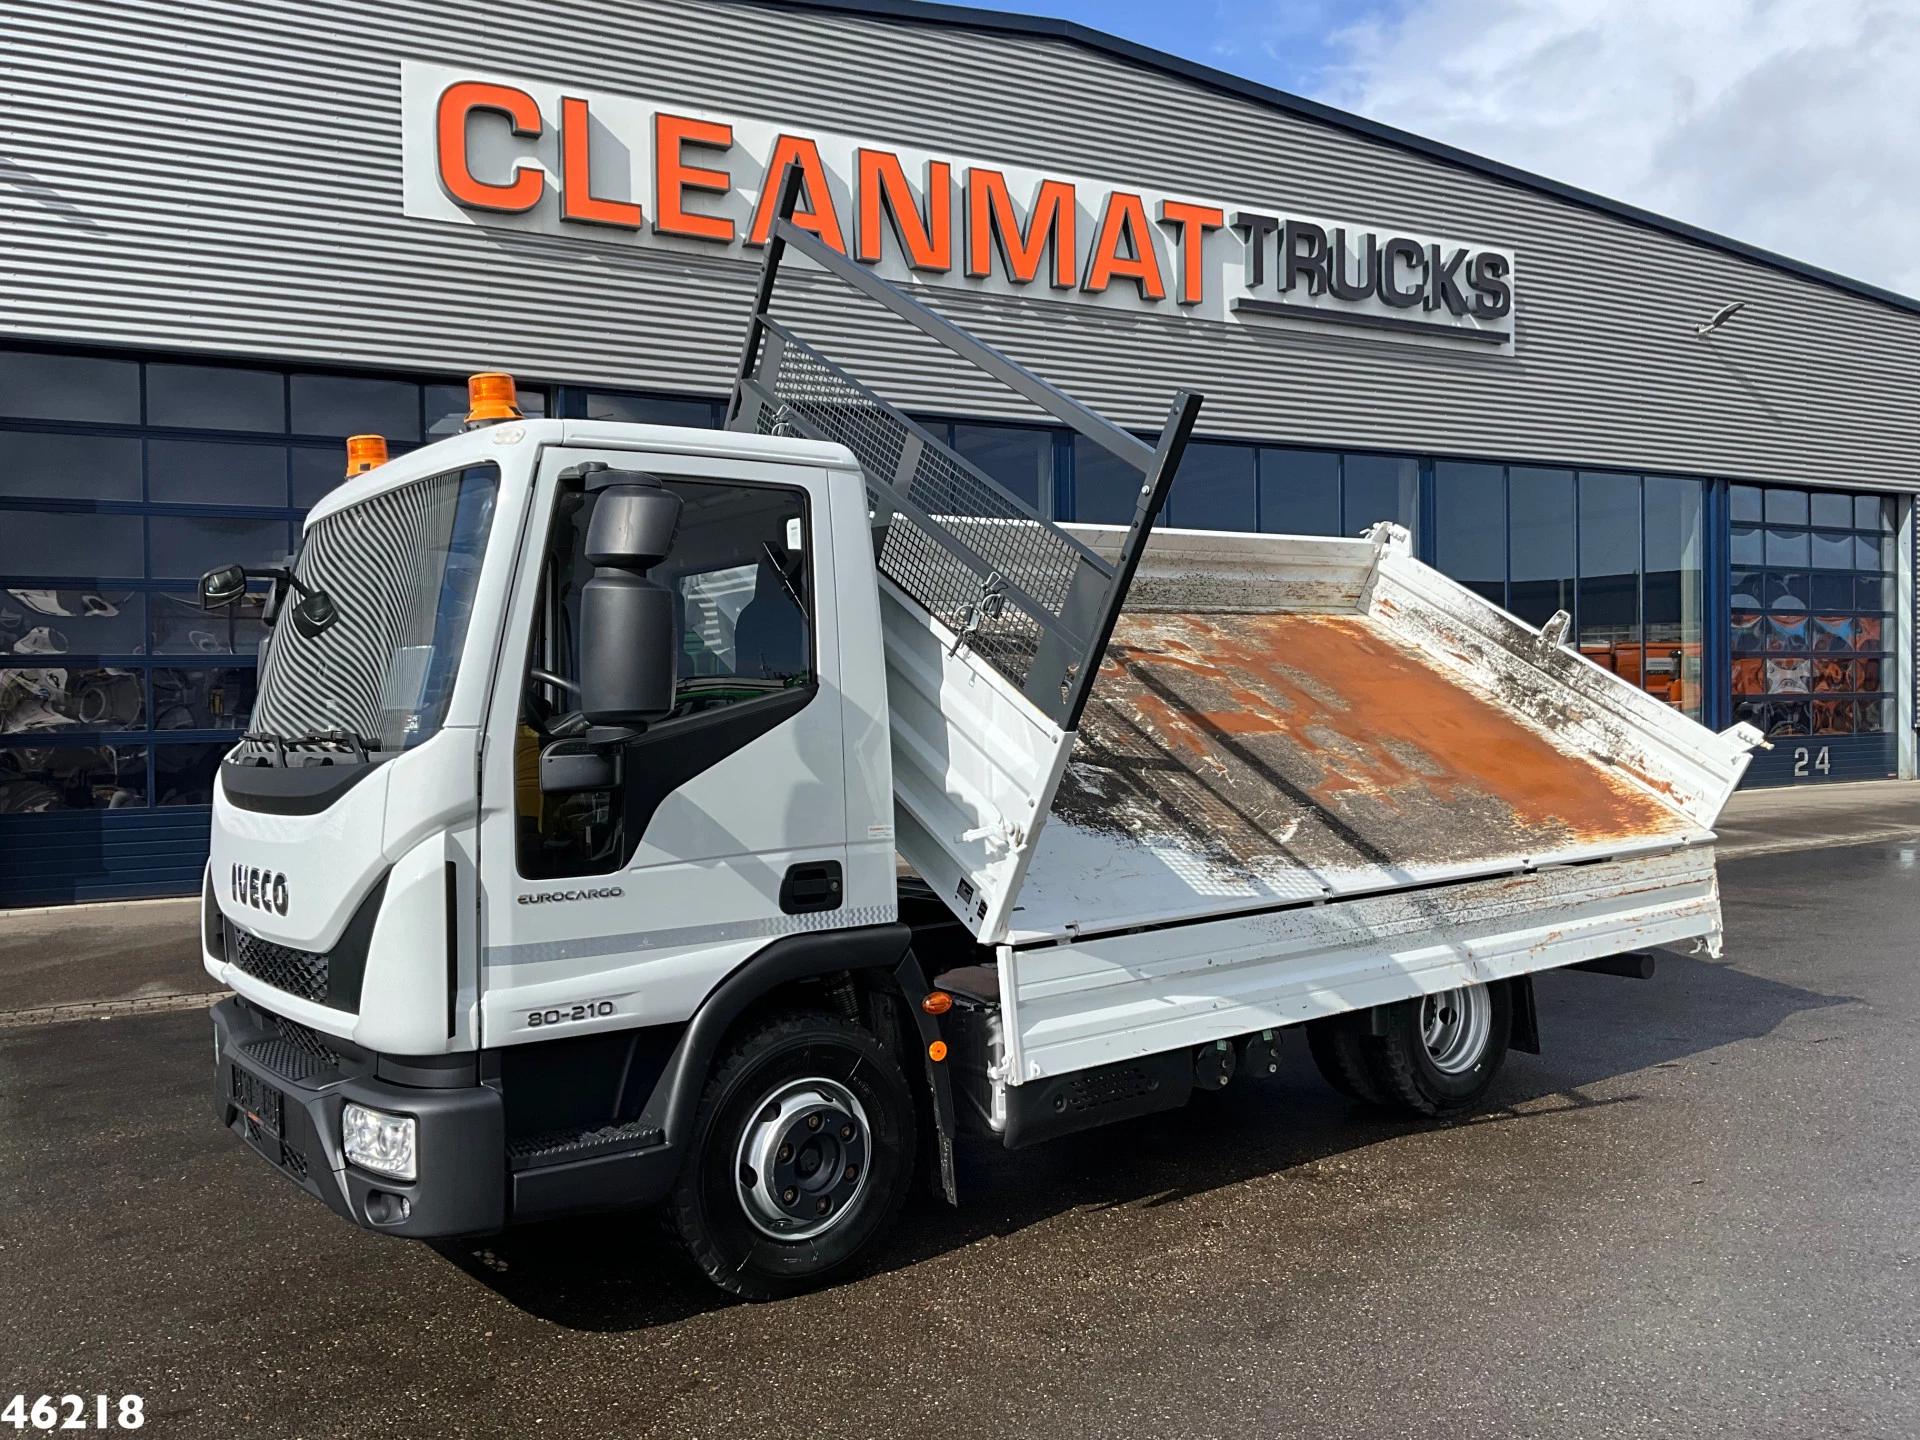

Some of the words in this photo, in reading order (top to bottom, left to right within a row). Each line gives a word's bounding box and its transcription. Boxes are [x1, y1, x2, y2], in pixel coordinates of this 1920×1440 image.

[435, 80, 1223, 306] CLEANMAT
[1230, 211, 1511, 321] TRUCKS
[1794, 746, 1831, 777] 24
[231, 862, 289, 917] IVECO
[517, 886, 625, 905] EUROCARGO
[527, 1001, 615, 1027] 80-210
